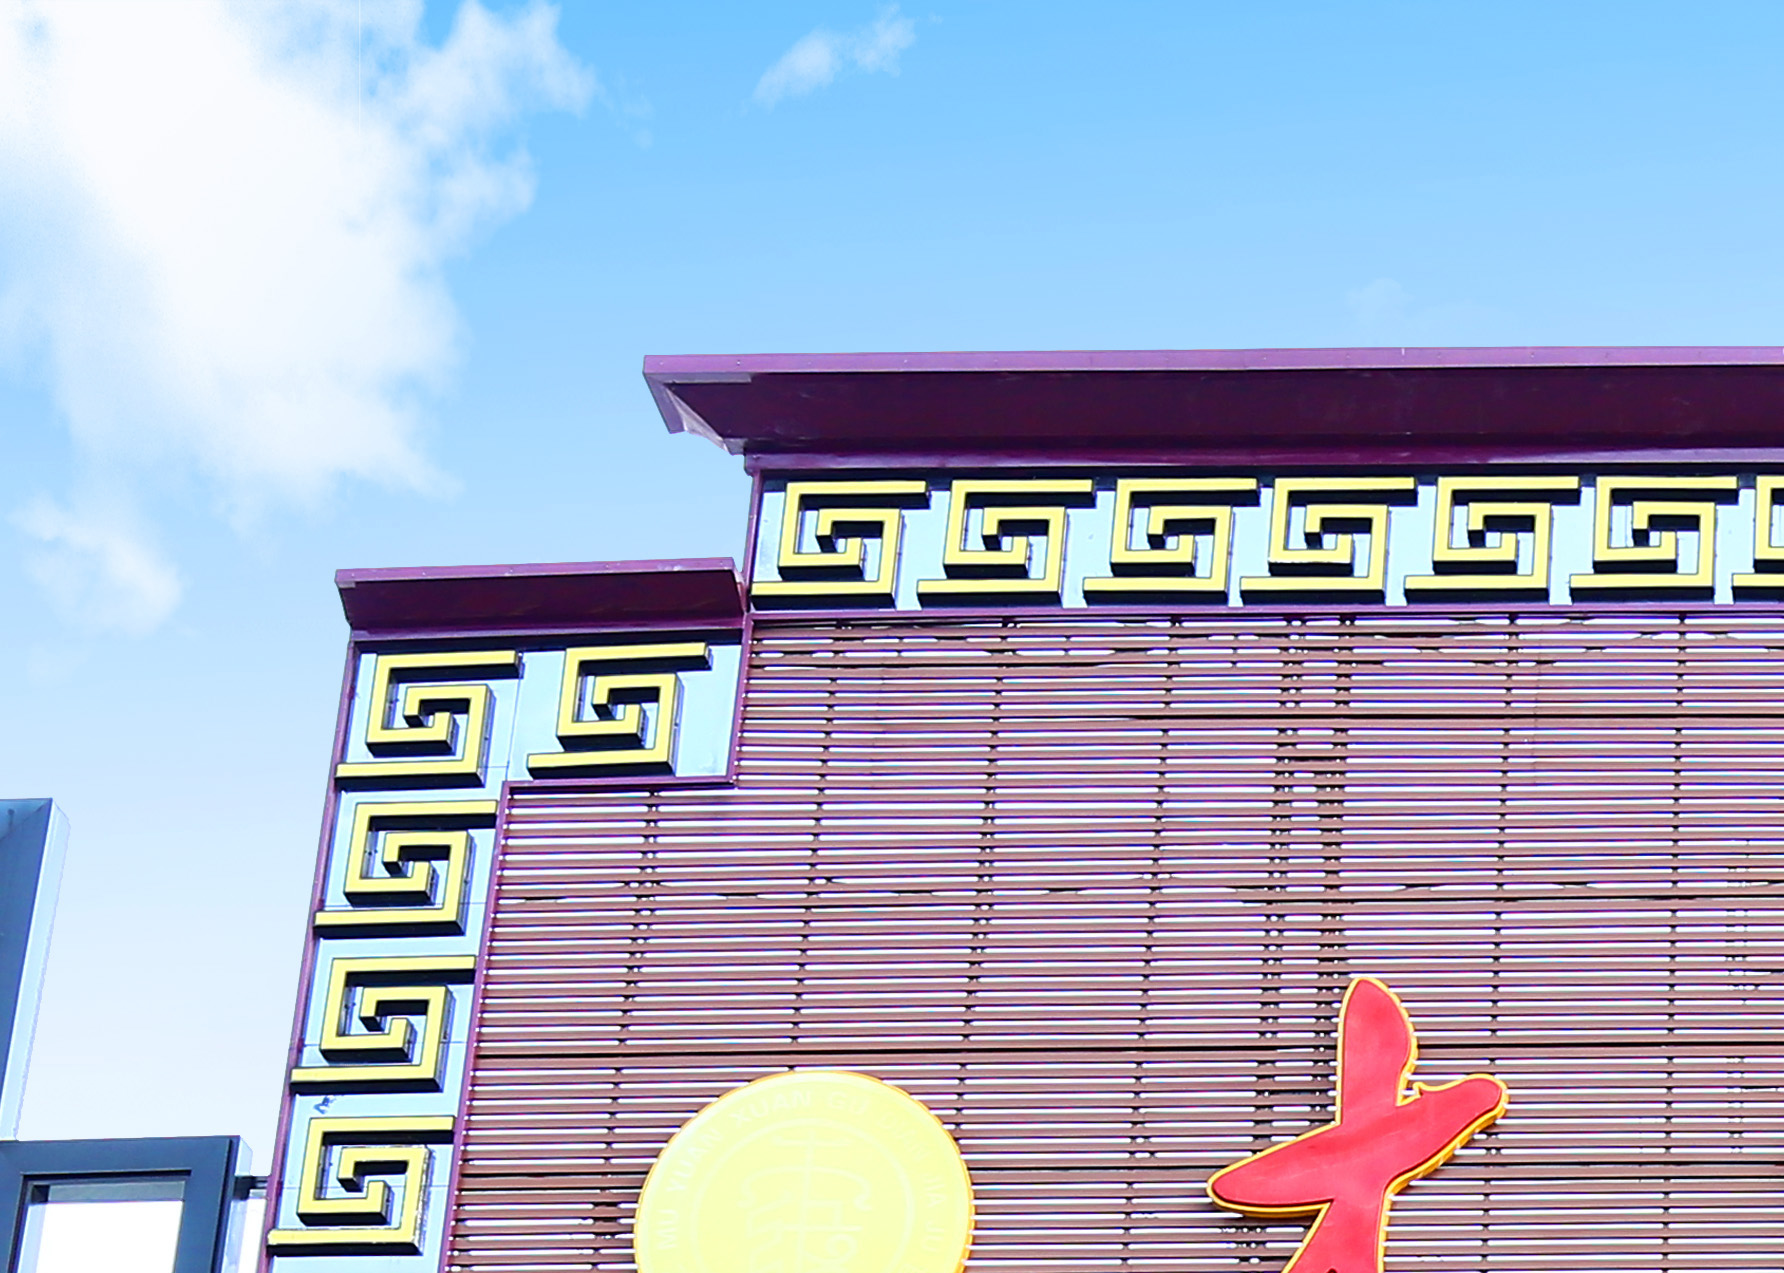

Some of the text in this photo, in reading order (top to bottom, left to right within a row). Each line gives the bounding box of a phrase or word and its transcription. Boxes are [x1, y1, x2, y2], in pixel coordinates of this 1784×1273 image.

[662, 1089, 949, 1252] MU YUAN XUAN GU DIAN JIA JU
